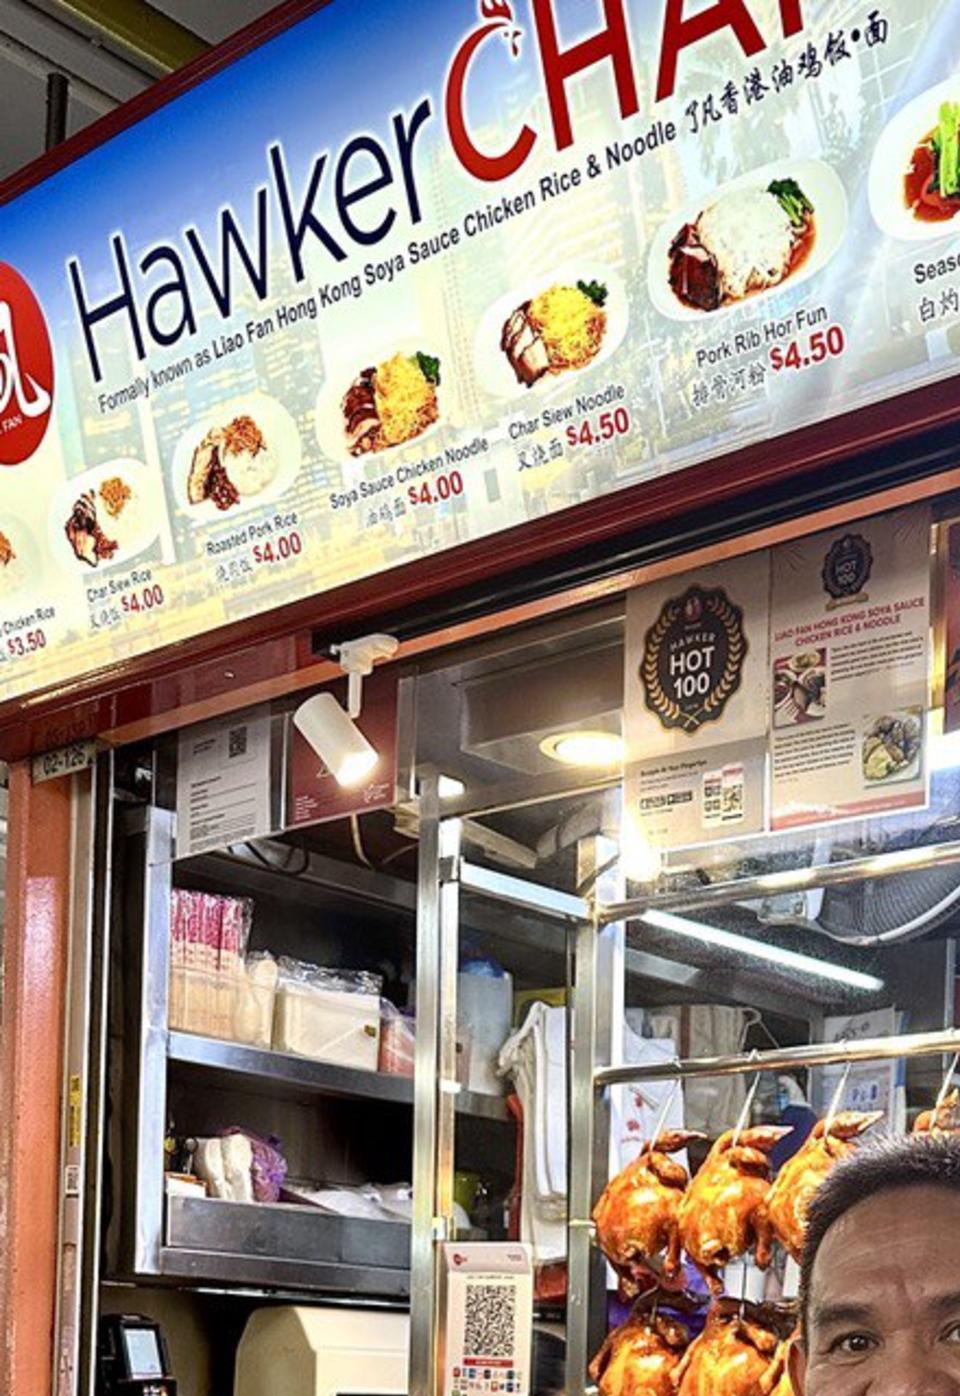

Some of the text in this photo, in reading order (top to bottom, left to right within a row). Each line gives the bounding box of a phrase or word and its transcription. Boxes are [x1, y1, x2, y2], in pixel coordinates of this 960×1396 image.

[66, 0, 806, 383] HawkerCHA
[98, 376, 149, 413] Formally
[151, 357, 194, 389] known
[195, 349, 212, 368] as
[212, 332, 244, 359] Liao
[246, 317, 274, 343] Fan
[276, 294, 317, 327] Hong
[319, 274, 363, 309] Kong
[364, 253, 407, 287] Soya
[408, 227, 460, 265] Sauce
[463, 189, 536, 236] Chicken
[540, 171, 582, 201] Rice
[586, 153, 601, 179] &
[605, 119, 677, 171] Noodle
[696, 305, 828, 369] Pork Rib Hor Fun
[769, 325, 845, 373] $4.50
[3, 414, 23, 434] FAN
[509, 383, 625, 441] Char Siew Noodle
[565, 407, 631, 447] $4.50
[329, 436, 489, 510] Soya Sauce Chicken Noodle
[407, 470, 465, 507] $4.00
[207, 511, 298, 557] Roasted Pork Rice
[253, 531, 302, 566] $4.00
[87, 582, 108, 603] Char
[132, 568, 152, 584] Rice
[121, 583, 164, 614] $4.00
[3, 606, 55, 635] Chicken Rice
[795, 630, 832, 647] CHICKEN
[834, 625, 853, 639] RICE
[863, 614, 902, 631] NOODLE
[813, 616, 838, 631] HONG
[840, 610, 866, 625] KONG
[867, 605, 891, 618] SOYA
[893, 597, 925, 613] SAUCE
[7, 628, 46, 656] $3.50
[670, 645, 716, 676] HOT
[673, 671, 710, 699] 100
